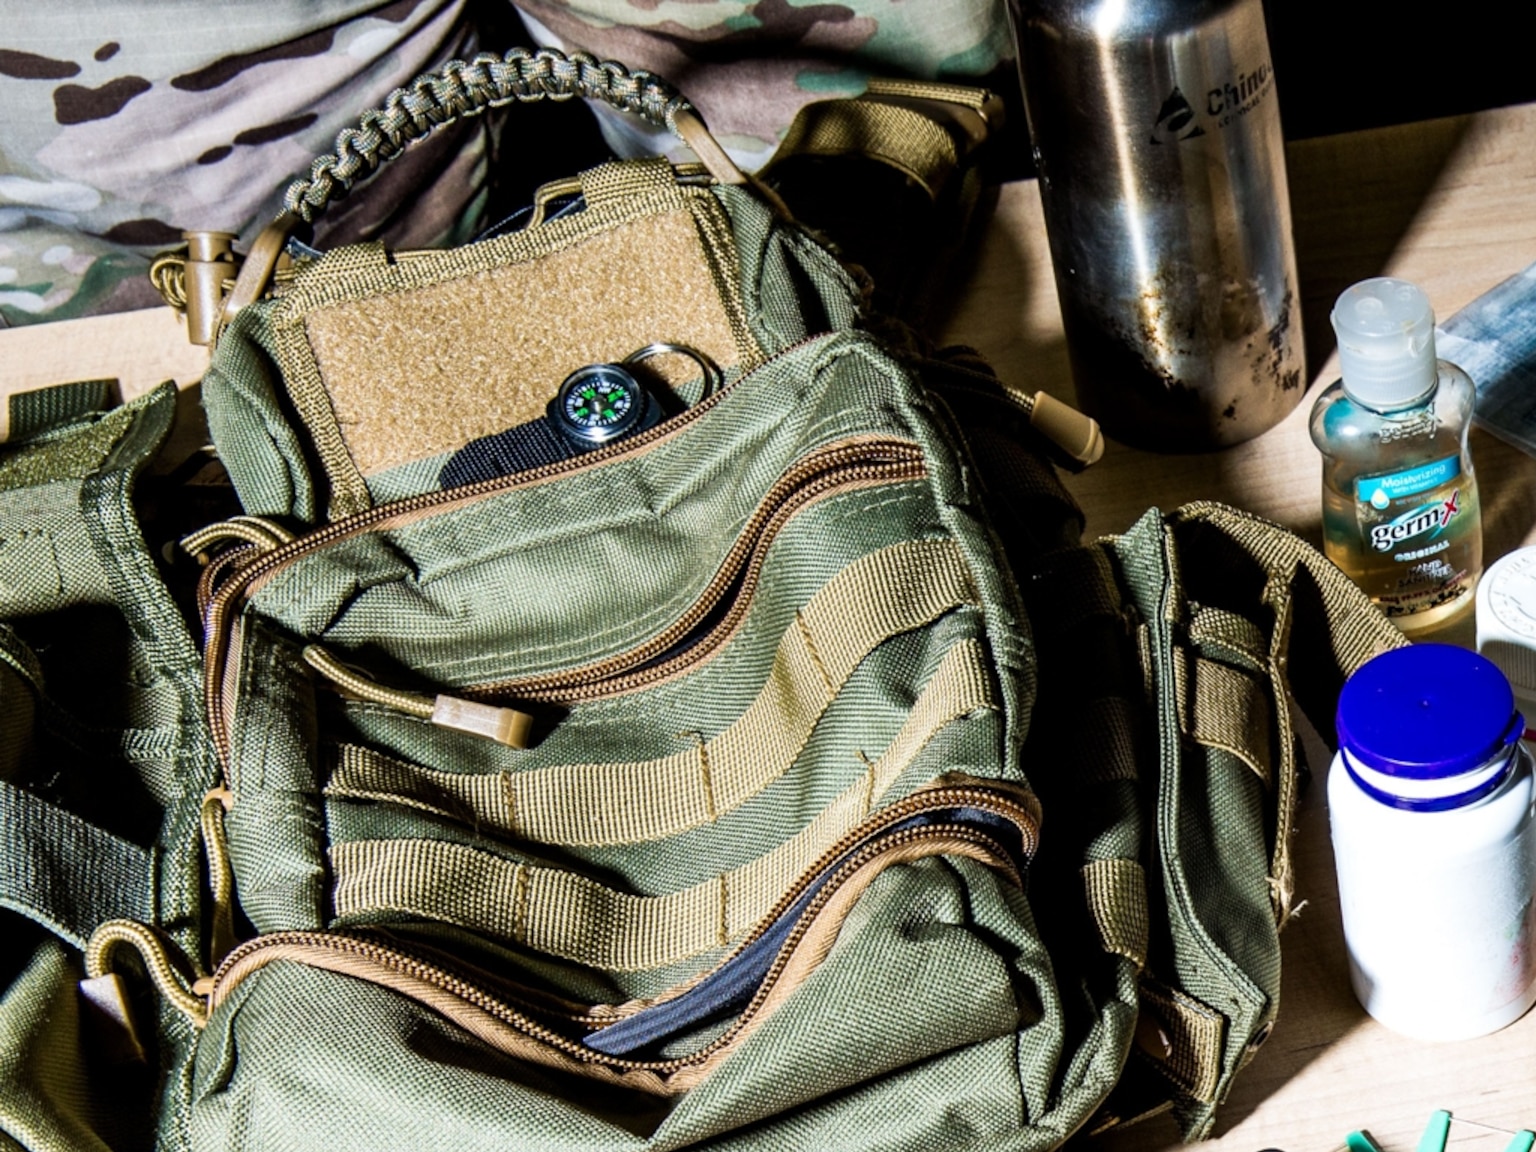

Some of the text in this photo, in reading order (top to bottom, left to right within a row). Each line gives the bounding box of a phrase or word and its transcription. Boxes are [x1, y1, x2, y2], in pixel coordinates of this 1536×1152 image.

[1207, 63, 1273, 116] Chino
[1381, 463, 1446, 490] Moisturizing
[1371, 489, 1461, 552] germ-X
[1394, 539, 1450, 562] ORIGINAL
